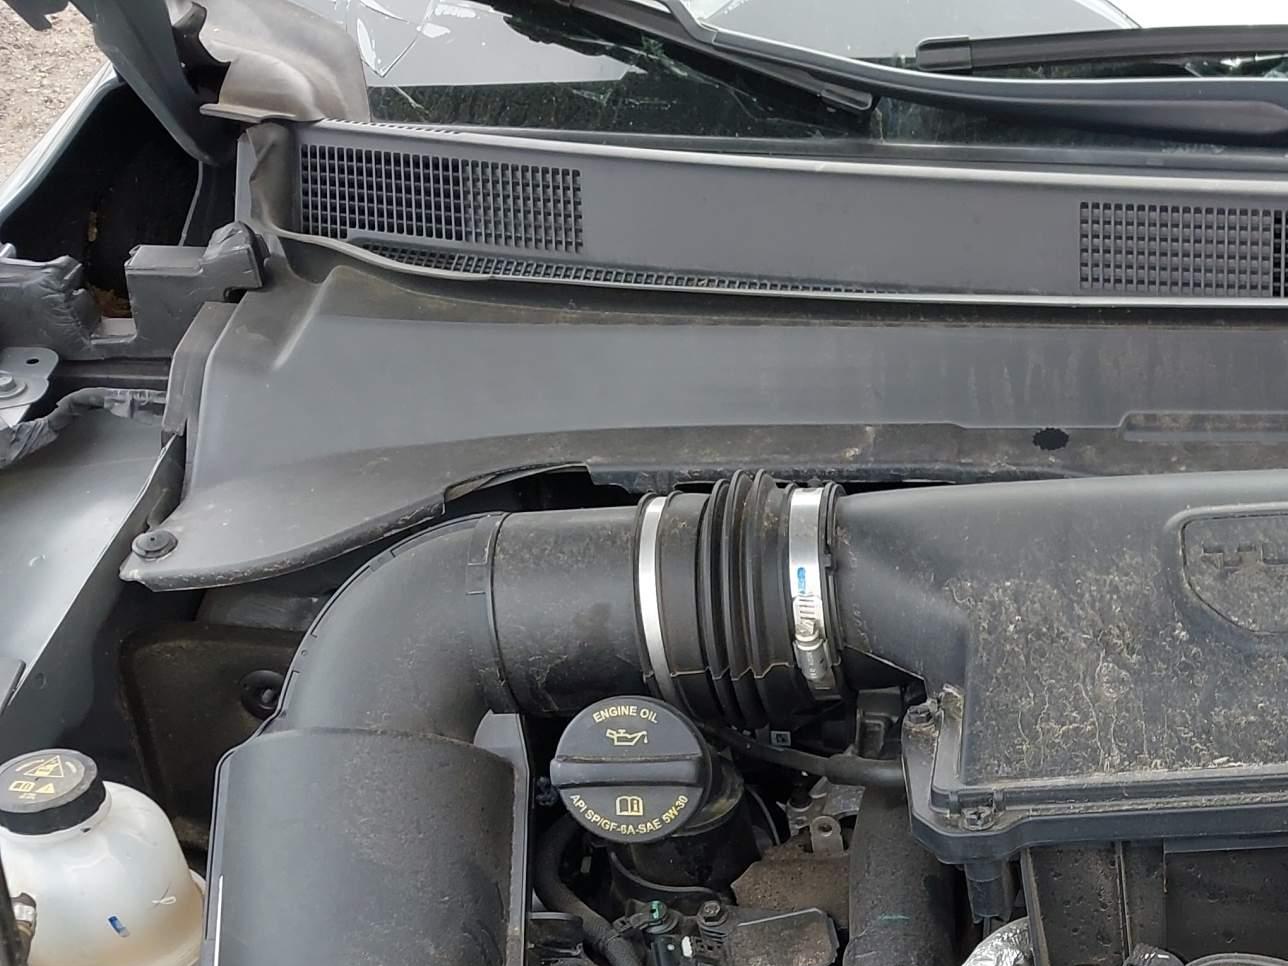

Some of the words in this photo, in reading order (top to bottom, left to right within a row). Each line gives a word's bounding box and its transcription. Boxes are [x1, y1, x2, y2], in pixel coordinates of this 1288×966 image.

[592, 705, 639, 723] ENGINE
[639, 708, 659, 723] OIL
[570, 794, 587, 812] API
[662, 795, 689, 824] 5W-30
